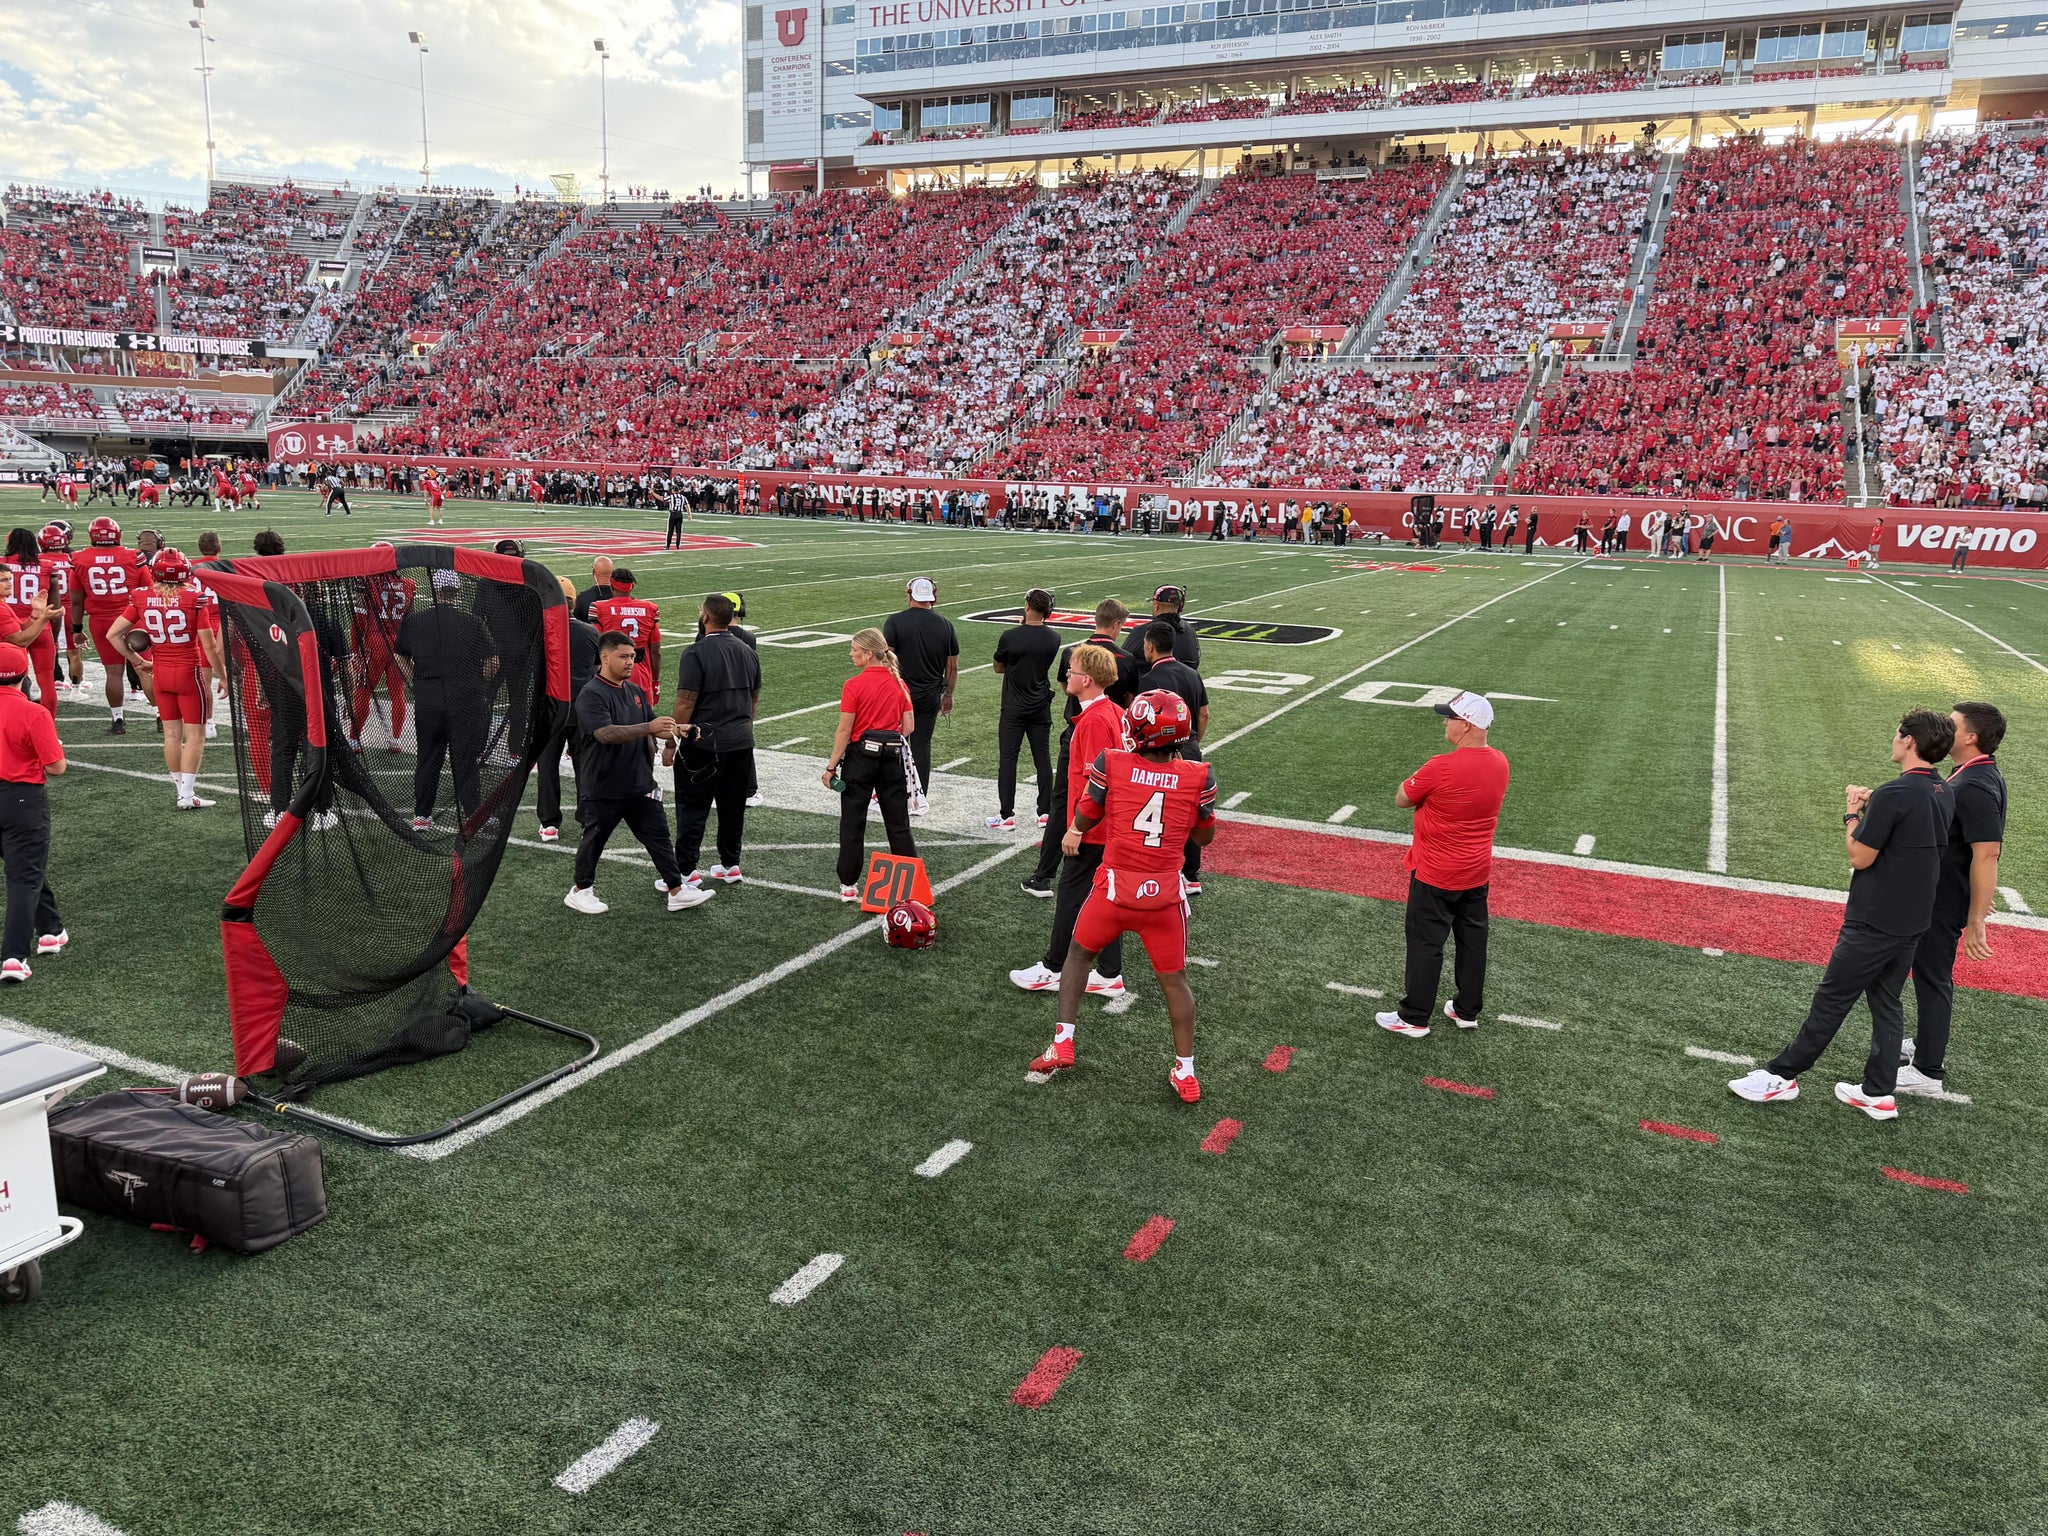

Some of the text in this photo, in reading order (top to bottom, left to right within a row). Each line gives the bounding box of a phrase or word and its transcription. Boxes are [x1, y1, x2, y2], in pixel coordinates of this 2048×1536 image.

[869, 3, 910, 27] THE
[775, 8, 807, 47] U
[771, 53, 812, 64] CONFERENCE
[773, 63, 811, 72] CHAMPIONS
[1309, 329, 1322, 338] 12
[1570, 325, 1585, 335] 13
[1865, 322, 1881, 332] 14
[19, 326, 60, 345] PROTECT
[60, 329, 84, 346] THIS
[422, 333, 428, 341] 7
[576, 335, 581, 343] 8
[731, 335, 737, 343] 9
[902, 335, 912, 343] 10
[1097, 333, 1106, 342] 11
[159, 335, 200, 353] PROTECT
[200, 338, 220, 354] THIS
[805, 484, 948, 509] NIVERSITY
[1897, 523, 2038, 554] venmo
[1849, 559, 1858, 568] 10
[87, 566, 129, 596] 62
[5, 573, 39, 605] 18
[147, 597, 179, 607] PHILPS
[610, 606, 646, 616] N. JOHNSON
[143, 609, 190, 644] 92
[1134, 703, 1148, 718] U
[1130, 767, 1179, 790] DAMPIER
[1132, 790, 1166, 848] 4
[866, 858, 915, 908] 20
